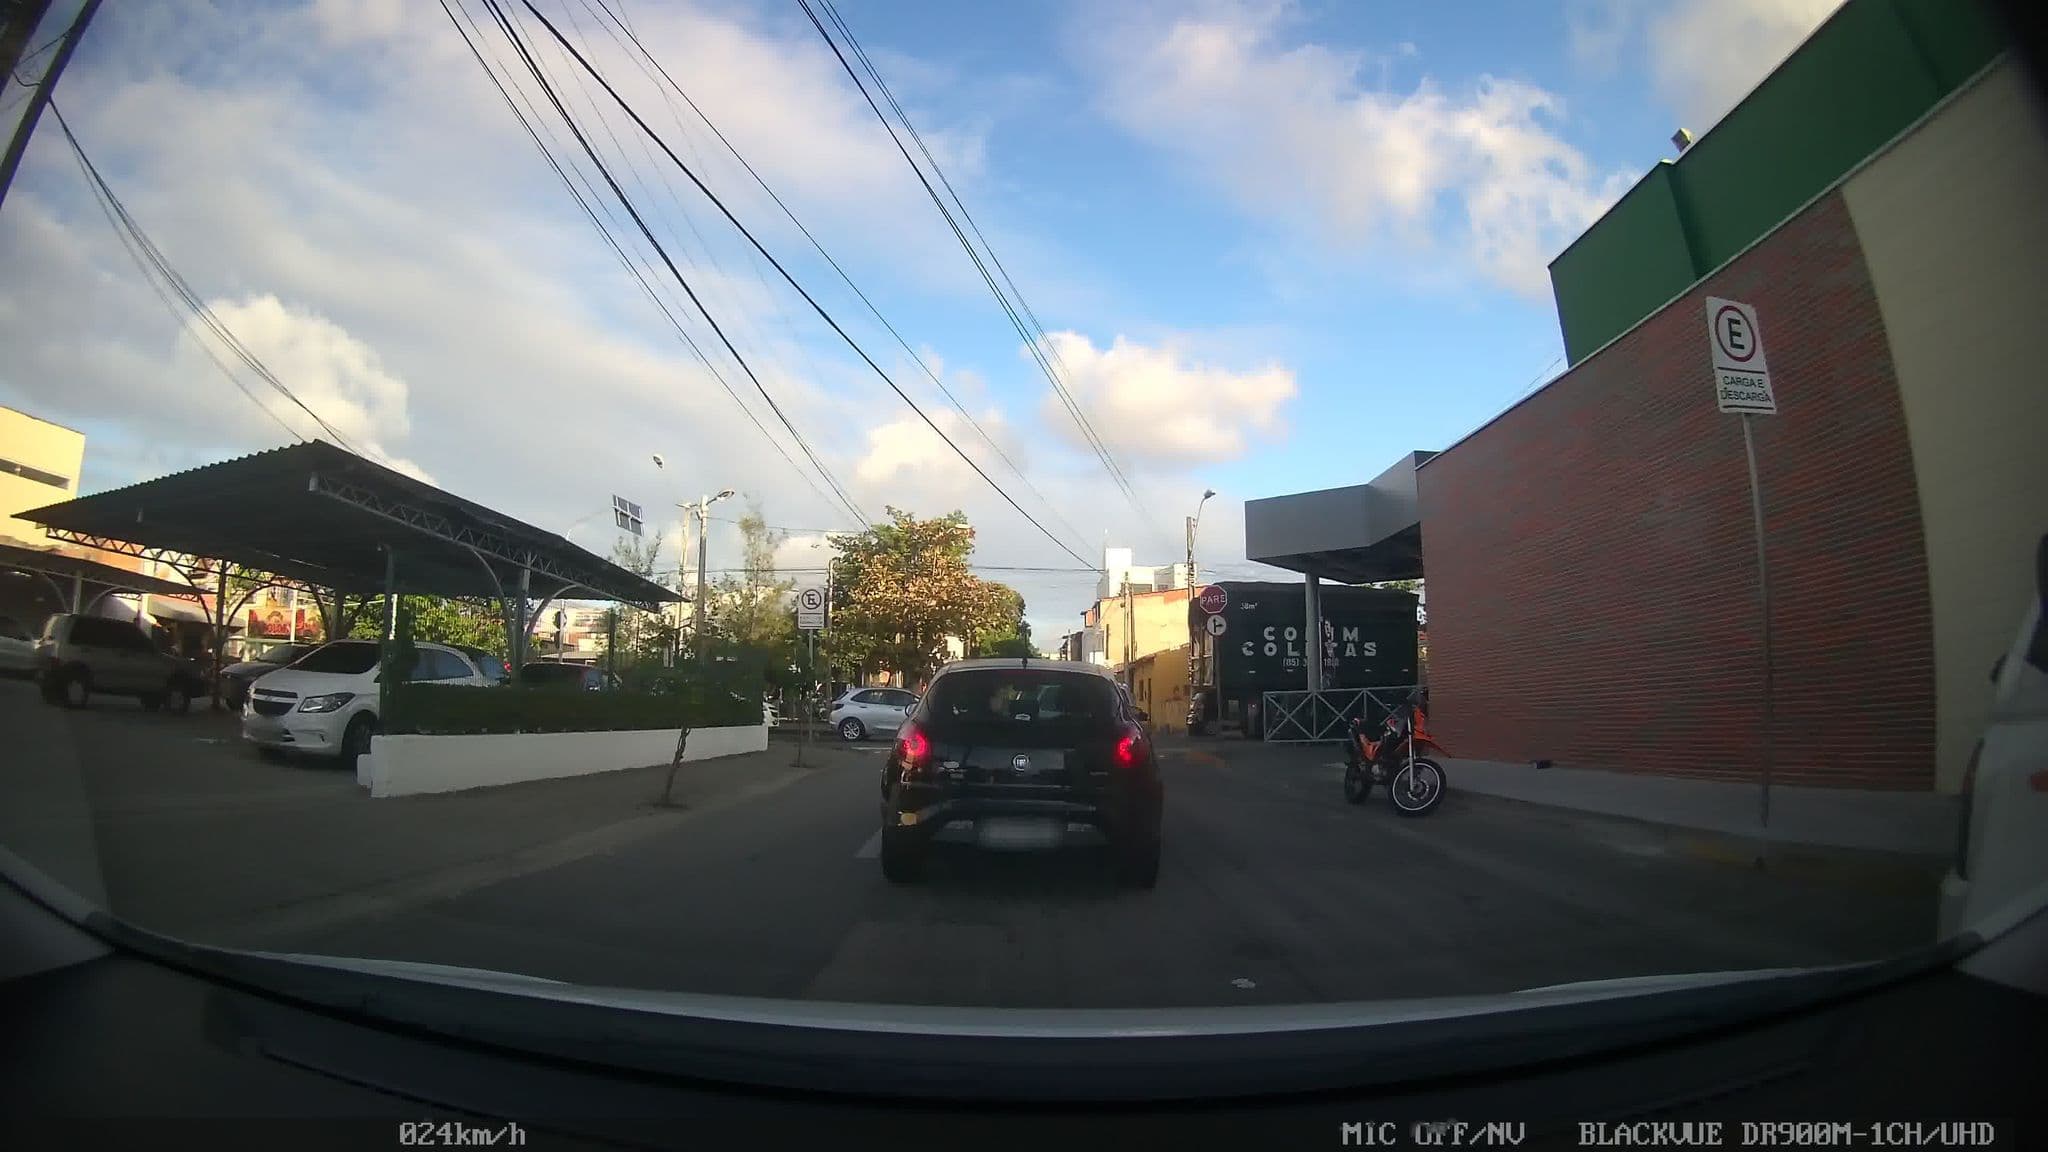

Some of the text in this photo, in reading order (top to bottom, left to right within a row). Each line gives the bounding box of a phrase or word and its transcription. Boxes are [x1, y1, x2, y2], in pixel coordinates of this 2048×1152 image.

[1727, 317, 1745, 350] E
[1722, 375, 1766, 389] CARGA E
[1719, 389, 1772, 402] DESCARGA
[1201, 594, 1226, 605] PARE
[1241, 641, 1377, 657] COLTAS
